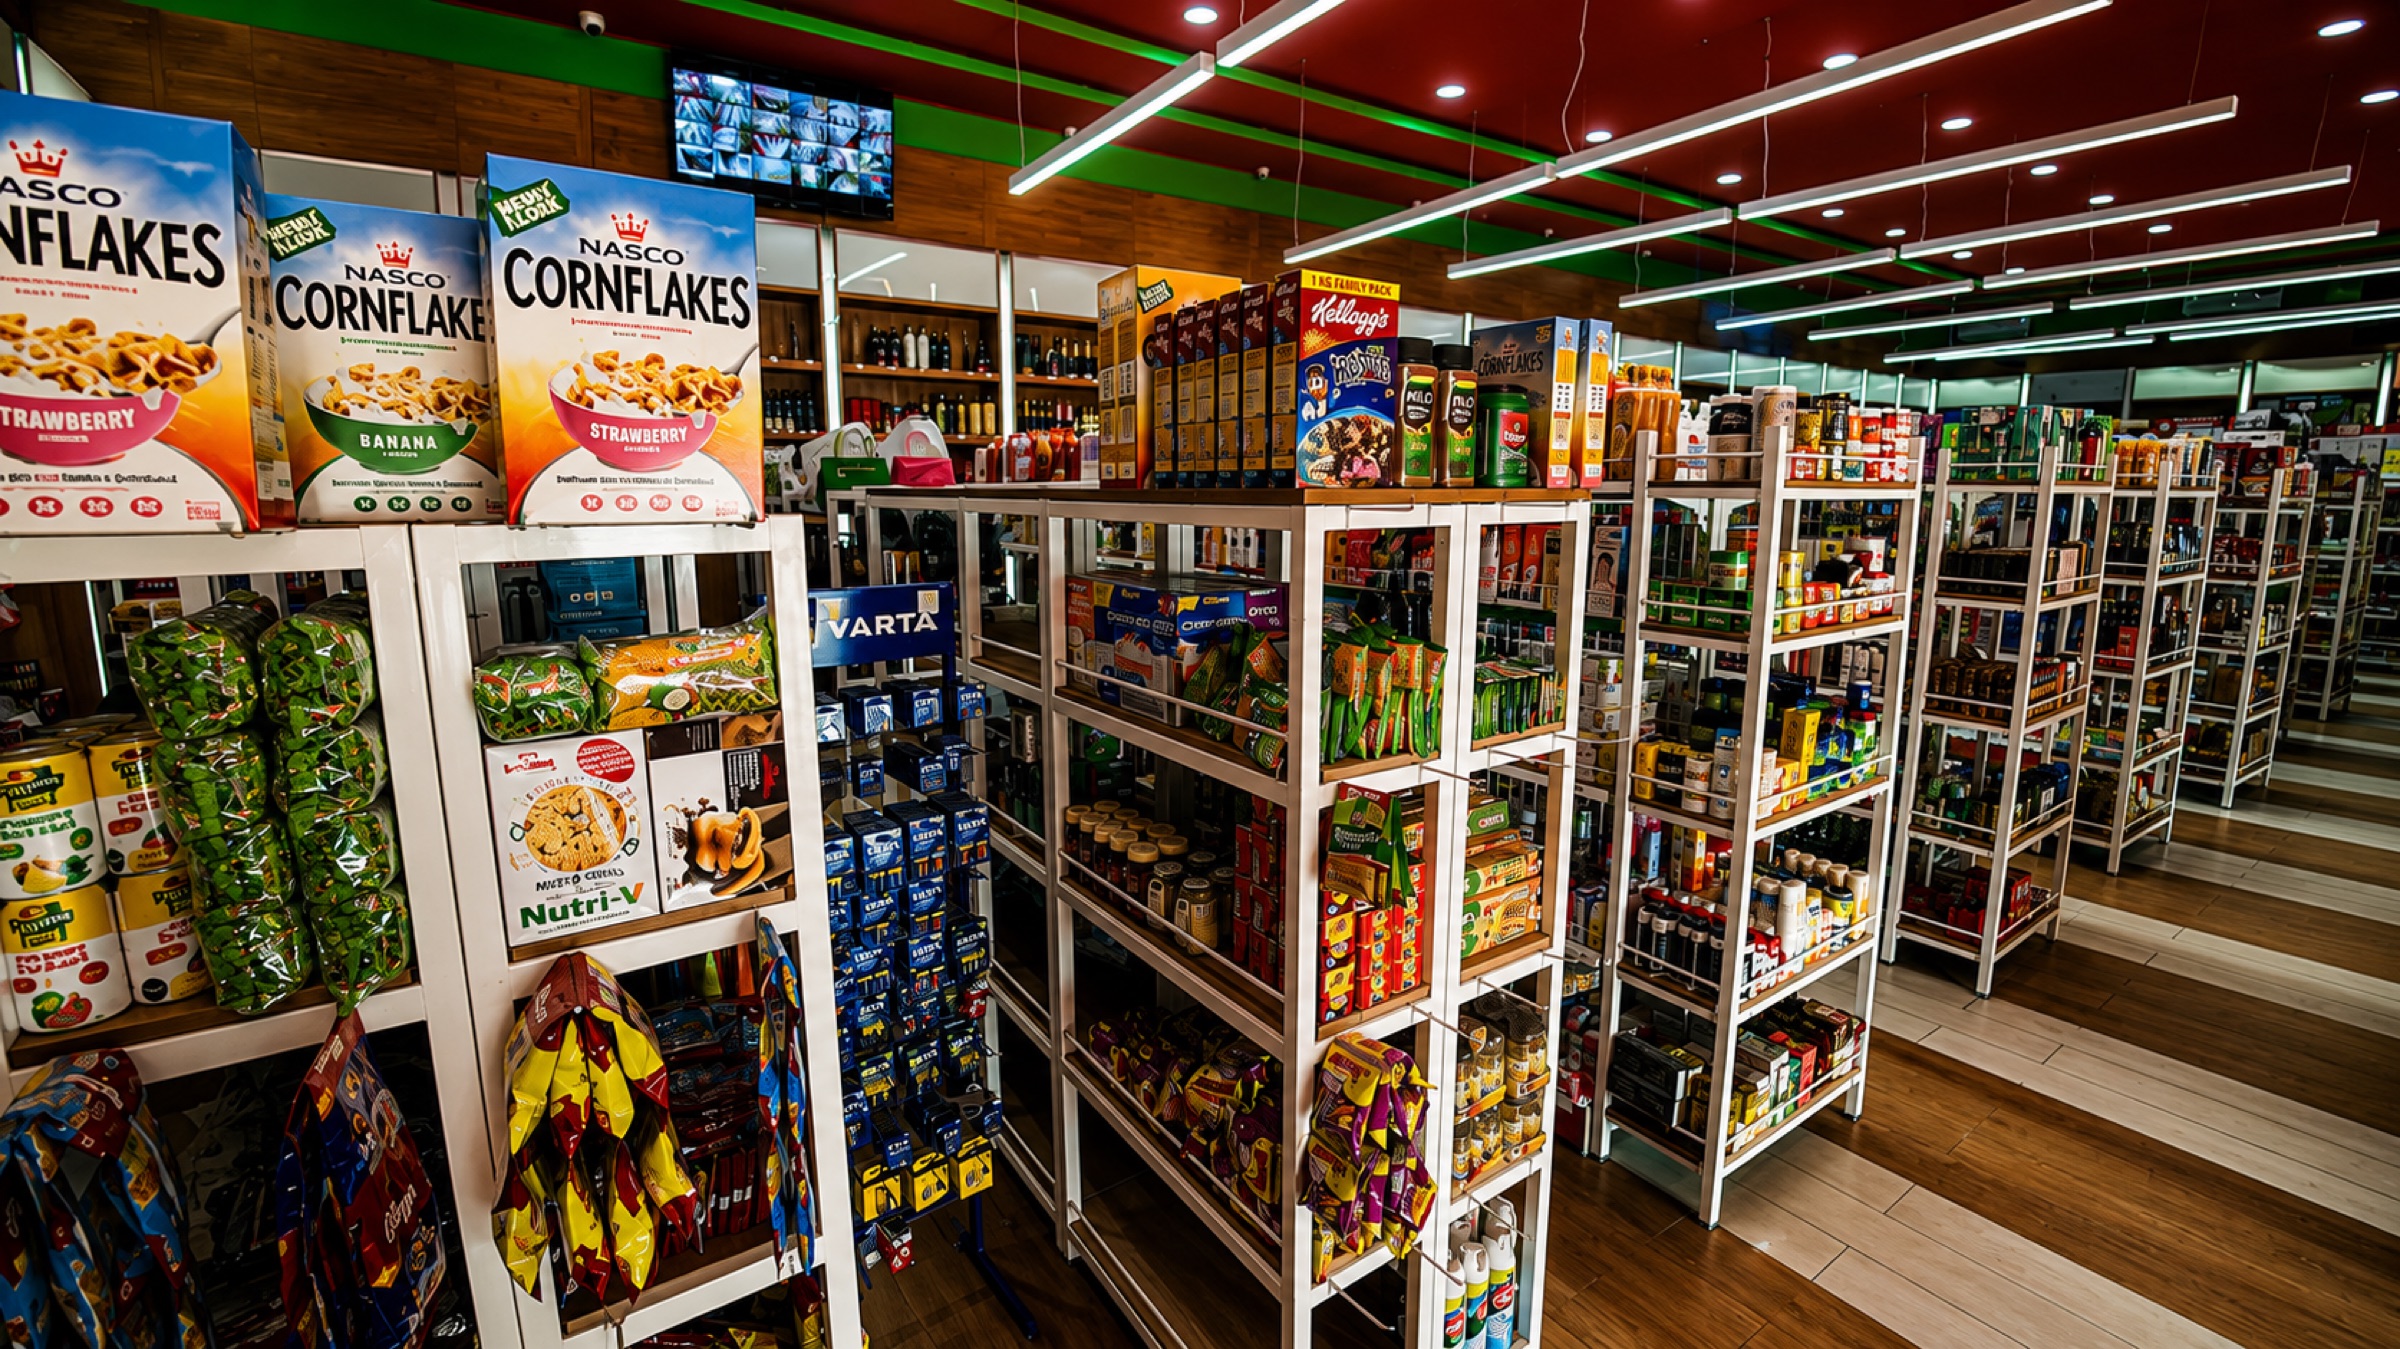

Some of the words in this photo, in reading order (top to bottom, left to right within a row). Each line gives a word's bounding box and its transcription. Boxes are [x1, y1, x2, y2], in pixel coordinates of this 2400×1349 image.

[0, 176, 122, 208] ASCO
[580, 238, 684, 265] NASCO
[345, 264, 446, 289] NASCO
[503, 247, 751, 329] CORNFLAKES
[1311, 293, 1389, 337] Kellogg's
[359, 433, 438, 450] BANANA
[590, 422, 688, 444] STRAWBERRY
[827, 612, 939, 639] VARTA
[520, 882, 645, 928] Nutri-V
